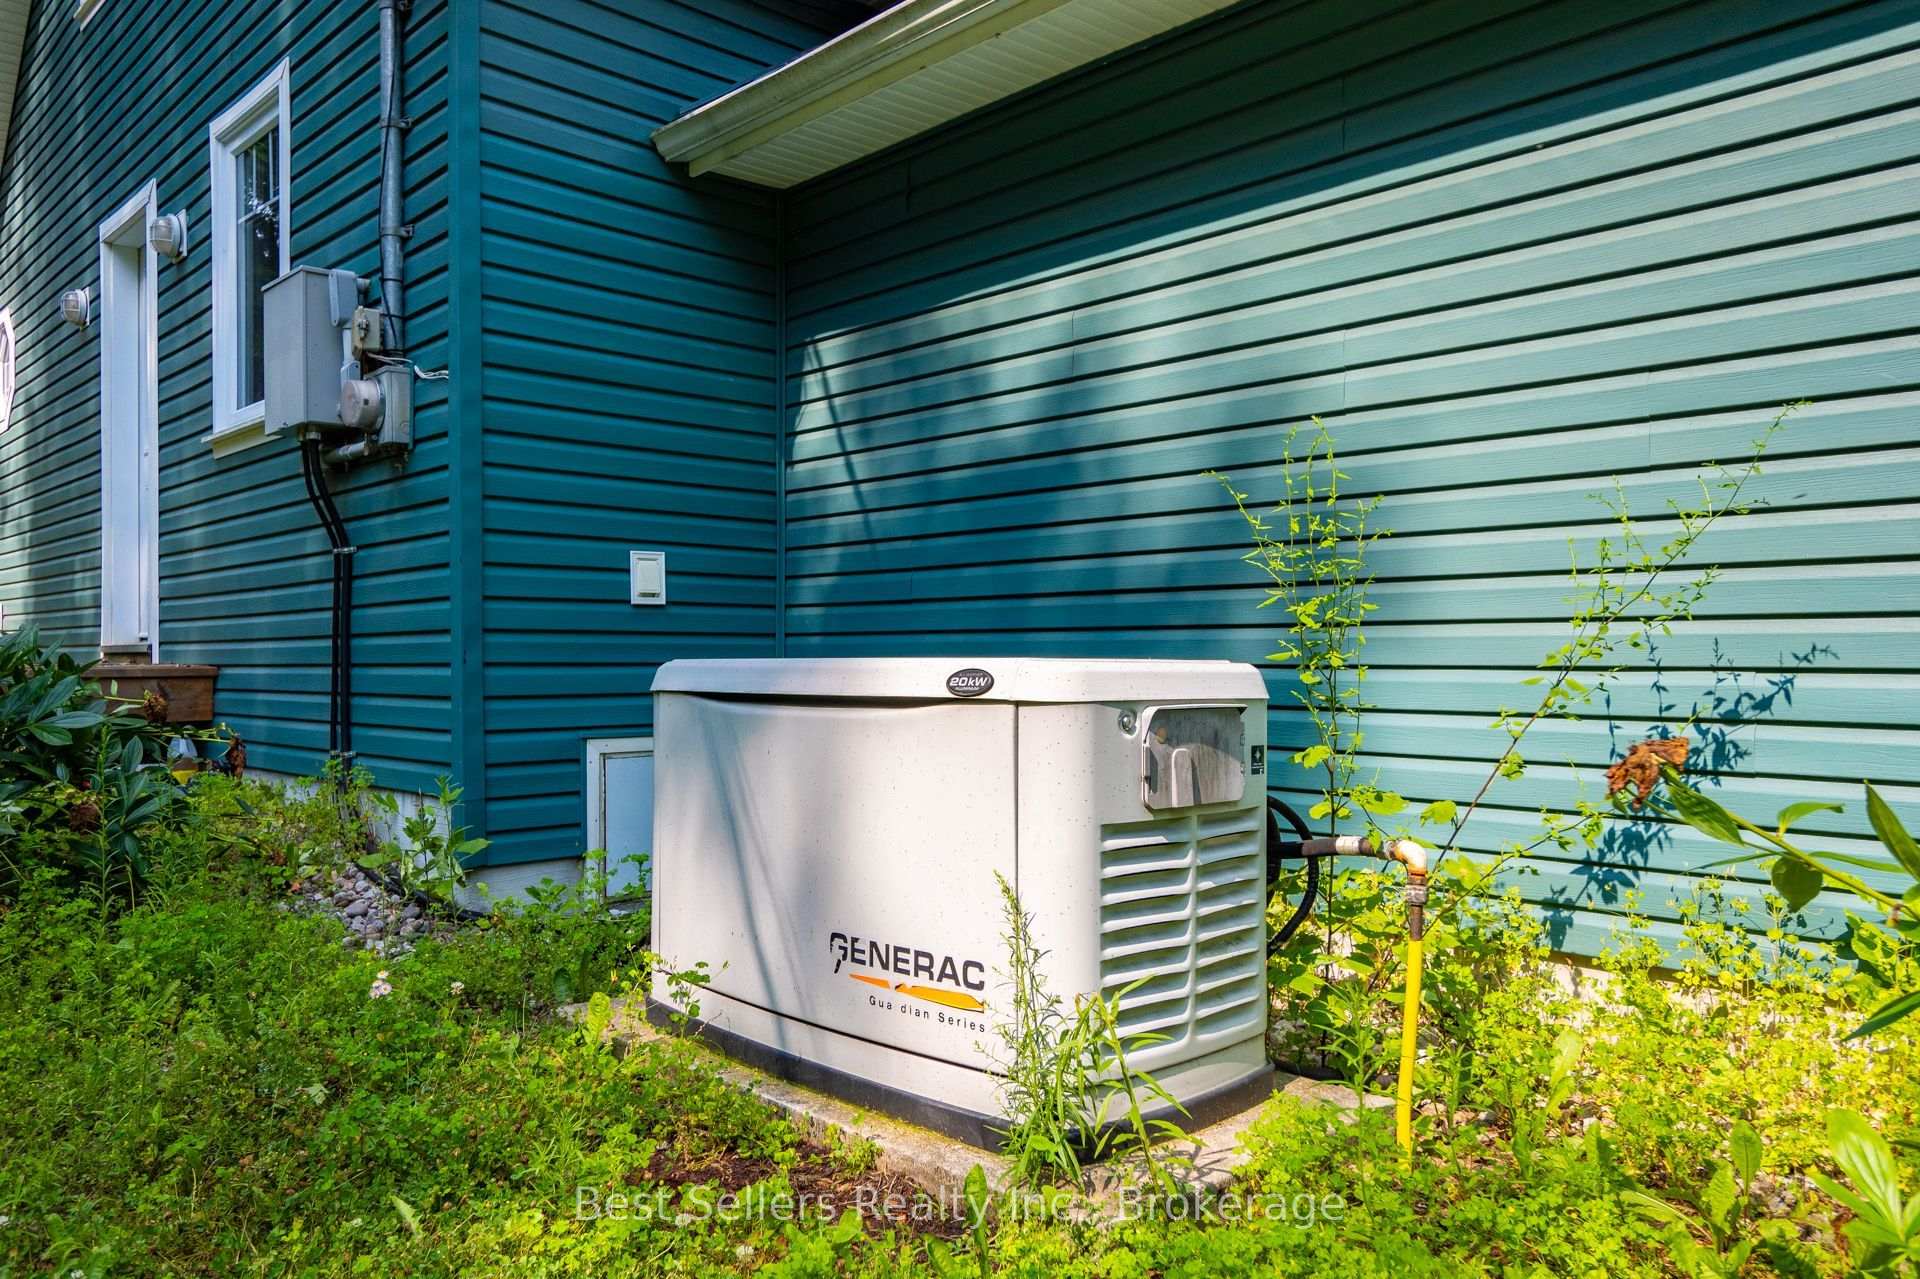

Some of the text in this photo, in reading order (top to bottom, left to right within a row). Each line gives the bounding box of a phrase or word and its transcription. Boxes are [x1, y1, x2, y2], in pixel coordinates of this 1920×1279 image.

[950, 676, 988, 687] 20kW
[869, 995, 985, 1033] Guadian Series
